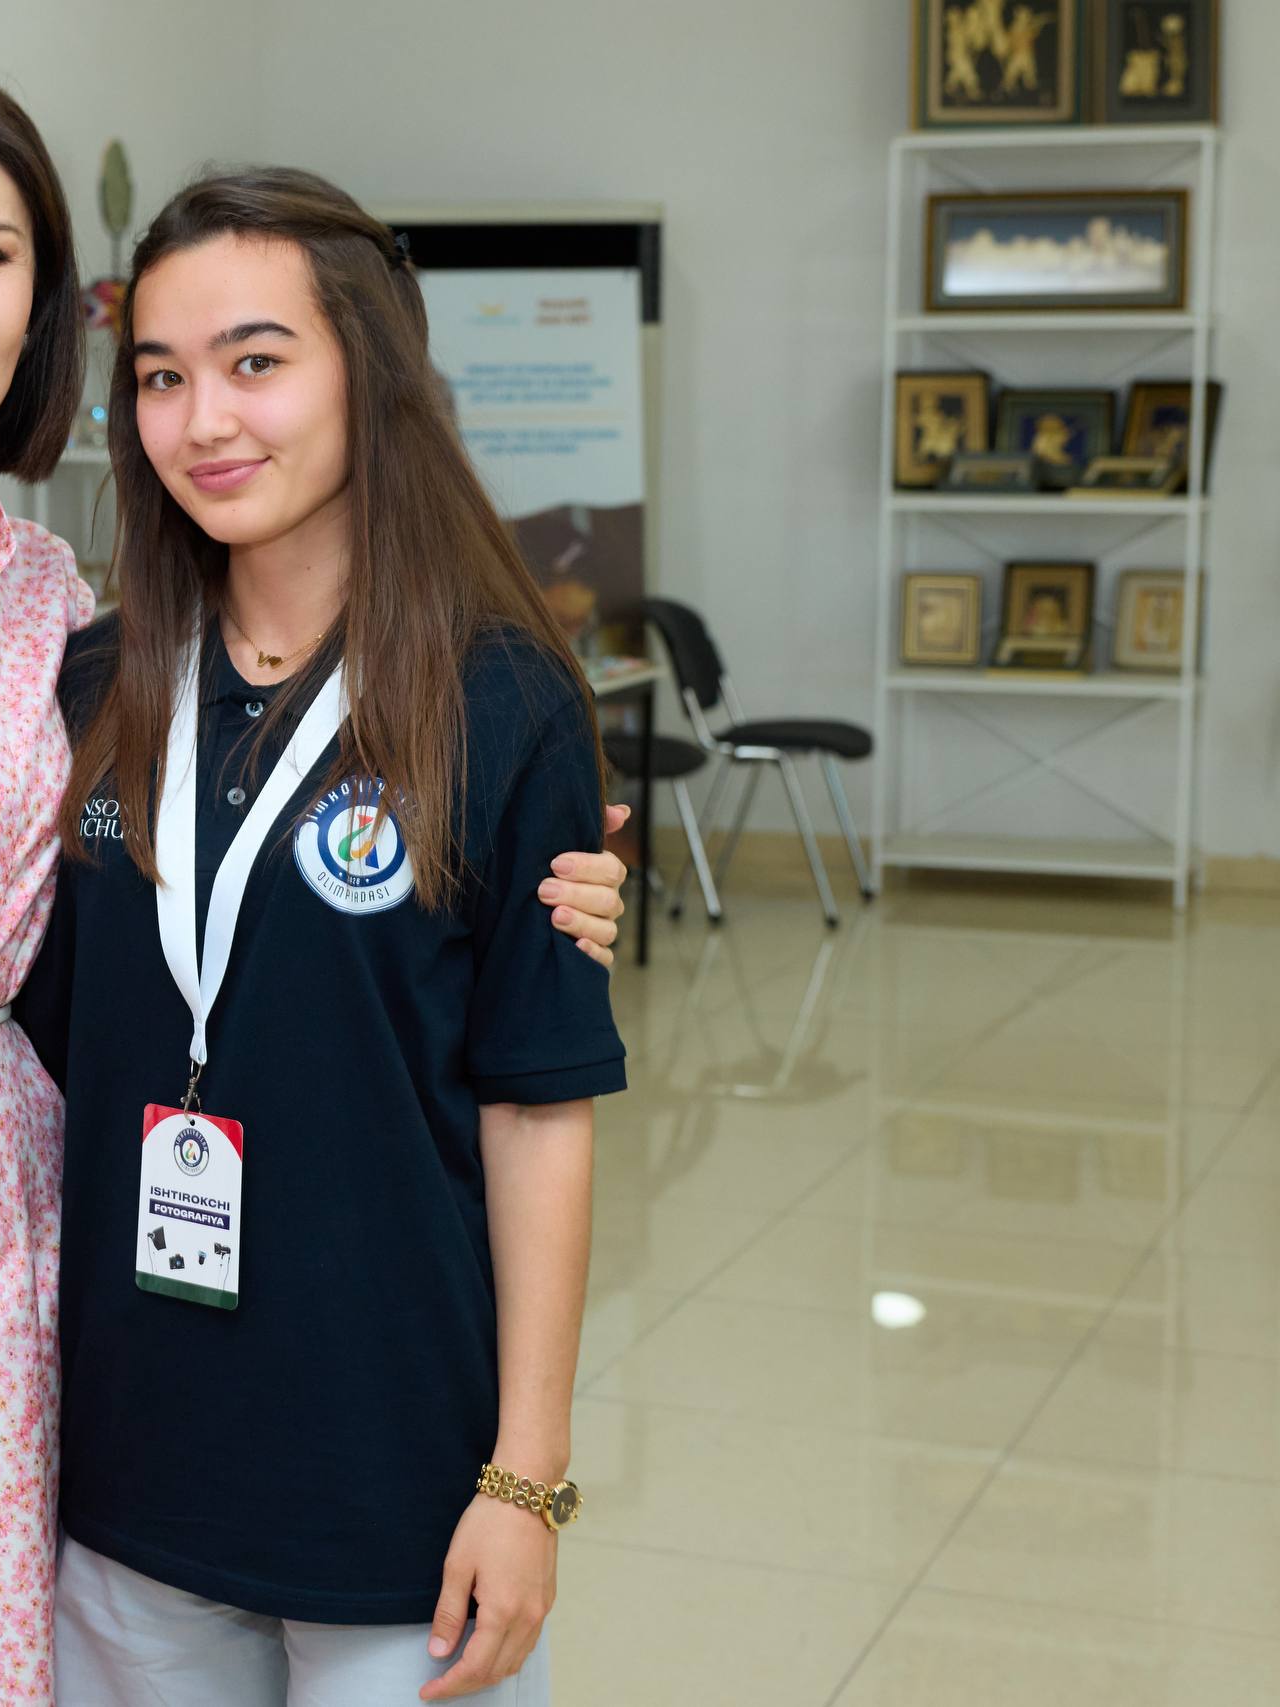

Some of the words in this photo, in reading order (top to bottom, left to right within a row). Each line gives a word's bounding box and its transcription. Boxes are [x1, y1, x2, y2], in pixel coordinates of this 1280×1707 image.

[317, 871, 390, 903] OLIMPIADASI
[150, 1185, 230, 1211] ISHTIROKCHI
[154, 1203, 224, 1226] FOTOGRAFIYA
